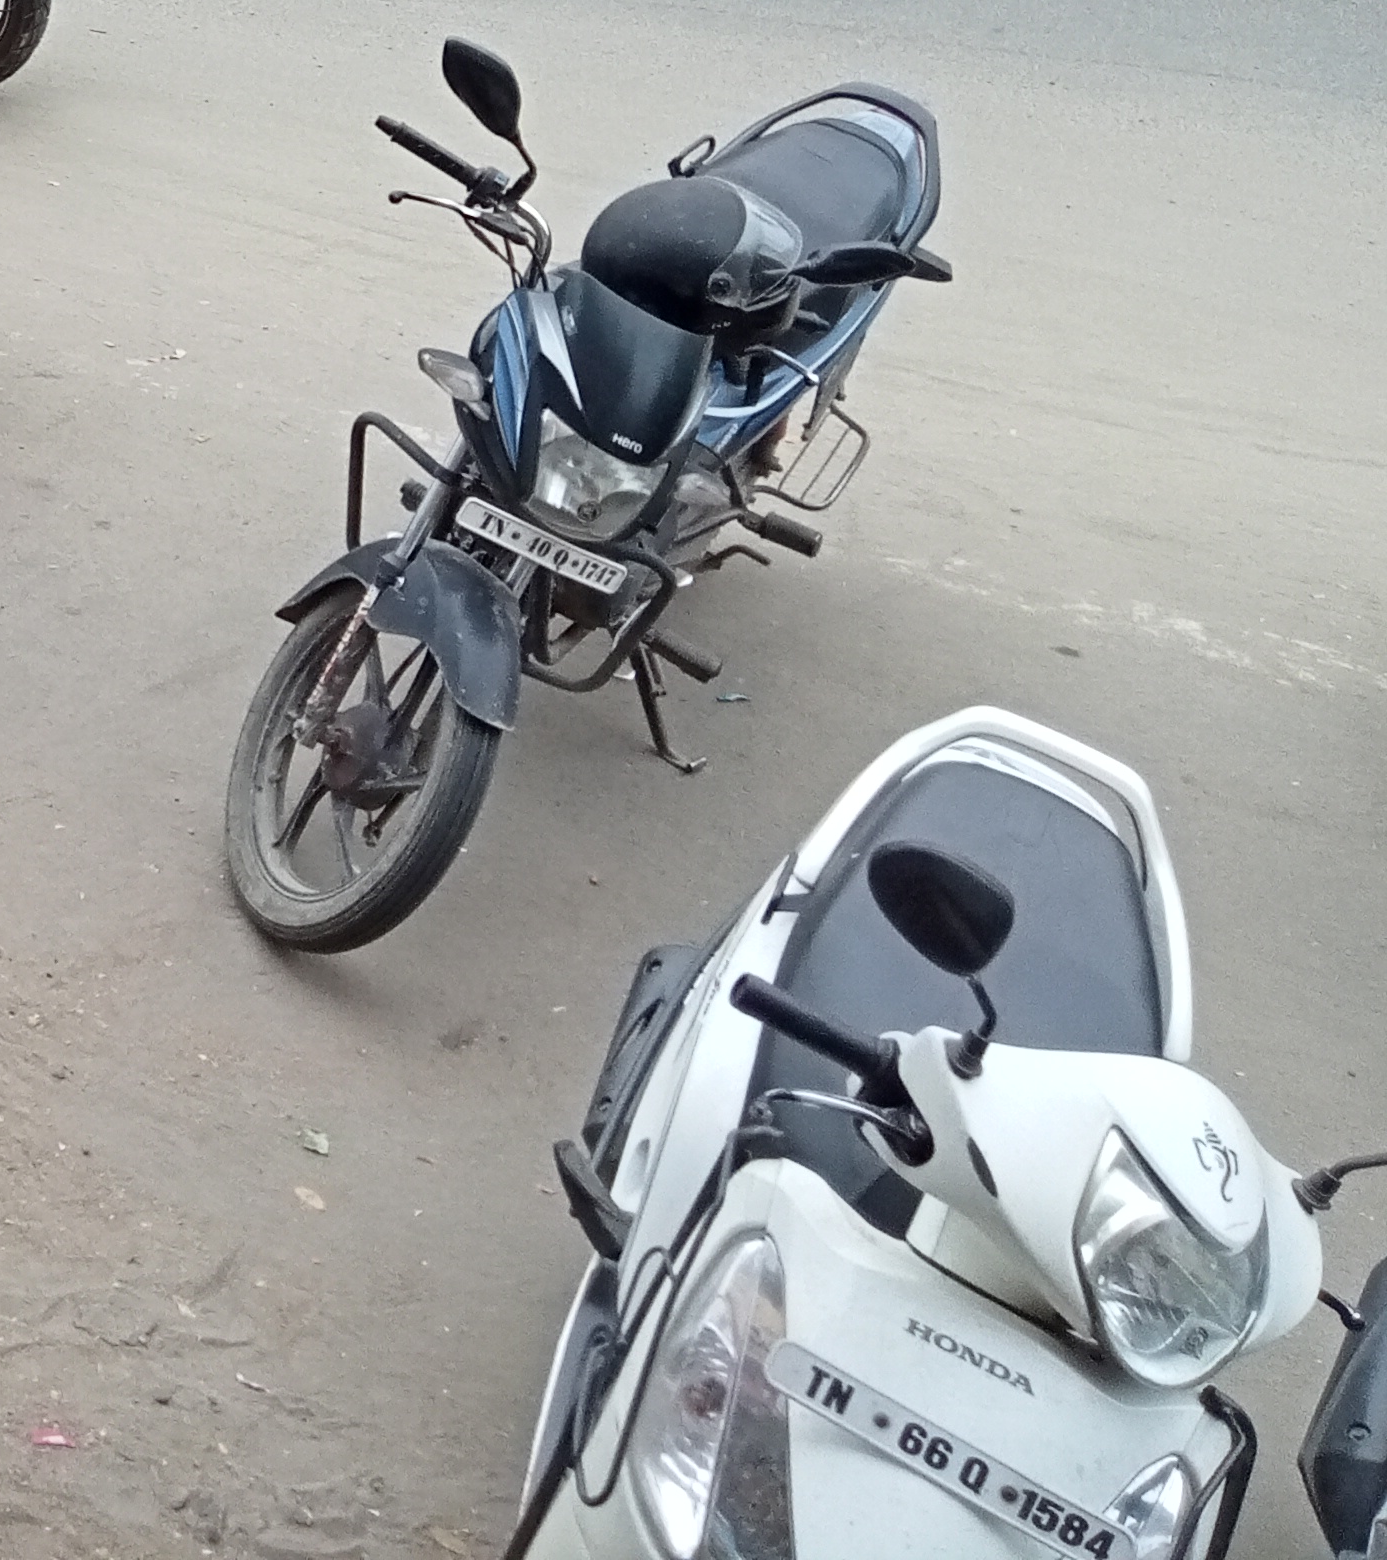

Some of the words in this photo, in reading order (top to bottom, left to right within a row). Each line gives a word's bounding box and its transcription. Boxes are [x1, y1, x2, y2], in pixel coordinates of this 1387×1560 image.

[479, 511, 510, 539] TN
[578, 559, 618, 587] 1747
[903, 1317, 1036, 1397] HONDA
[805, 1365, 856, 1415] TN
[897, 1422, 954, 1471] 66
[958, 1456, 990, 1495] Q
[1015, 1488, 1116, 1560] 1584
